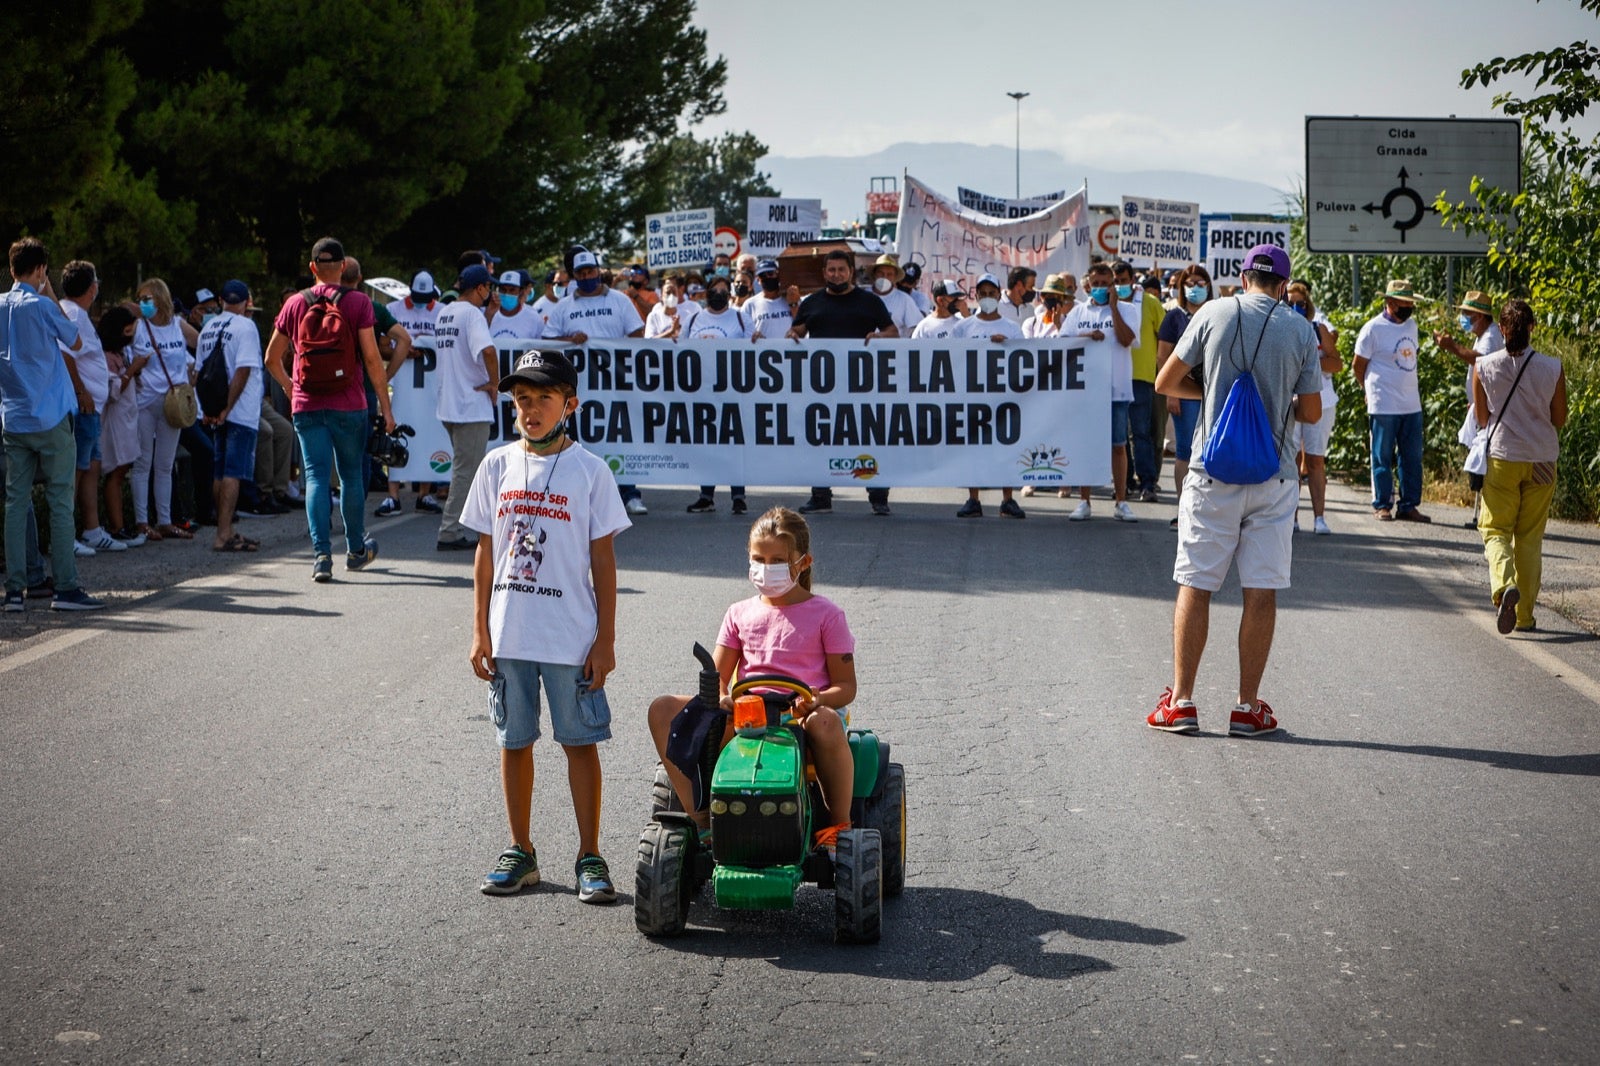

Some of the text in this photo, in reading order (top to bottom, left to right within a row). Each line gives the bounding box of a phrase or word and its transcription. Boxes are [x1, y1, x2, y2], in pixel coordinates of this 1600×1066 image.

[1376, 145, 1428, 156] Granada
[769, 205, 798, 222] POR LA
[1316, 202, 1356, 212] Puleva
[649, 231, 713, 250] CON EL SECTOR
[1122, 221, 1194, 243] CON EL SECTOR
[1211, 229, 1285, 249] PRECIOS
[649, 246, 713, 267] LACTEO ESPAÑOL
[1120, 240, 1193, 261] LACTEO ESPAÑOL
[1212, 258, 1244, 280] JUS
[564, 348, 702, 393] PRECIO
[712, 350, 836, 394] JUSTO
[848, 350, 898, 394] DE
[909, 349, 956, 394] LA
[966, 348, 1086, 393] LECHE
[643, 401, 746, 445] PARA
[755, 403, 795, 446] EL
[804, 402, 1022, 447] GANADERO
[625, 454, 674, 462] cooperativas
[830, 459, 875, 469] COAG
[549, 494, 568, 506] SER
[514, 504, 572, 522] GENERACIÓN
[508, 582, 535, 593] PRECIO
[537, 587, 563, 598] JUSTO
